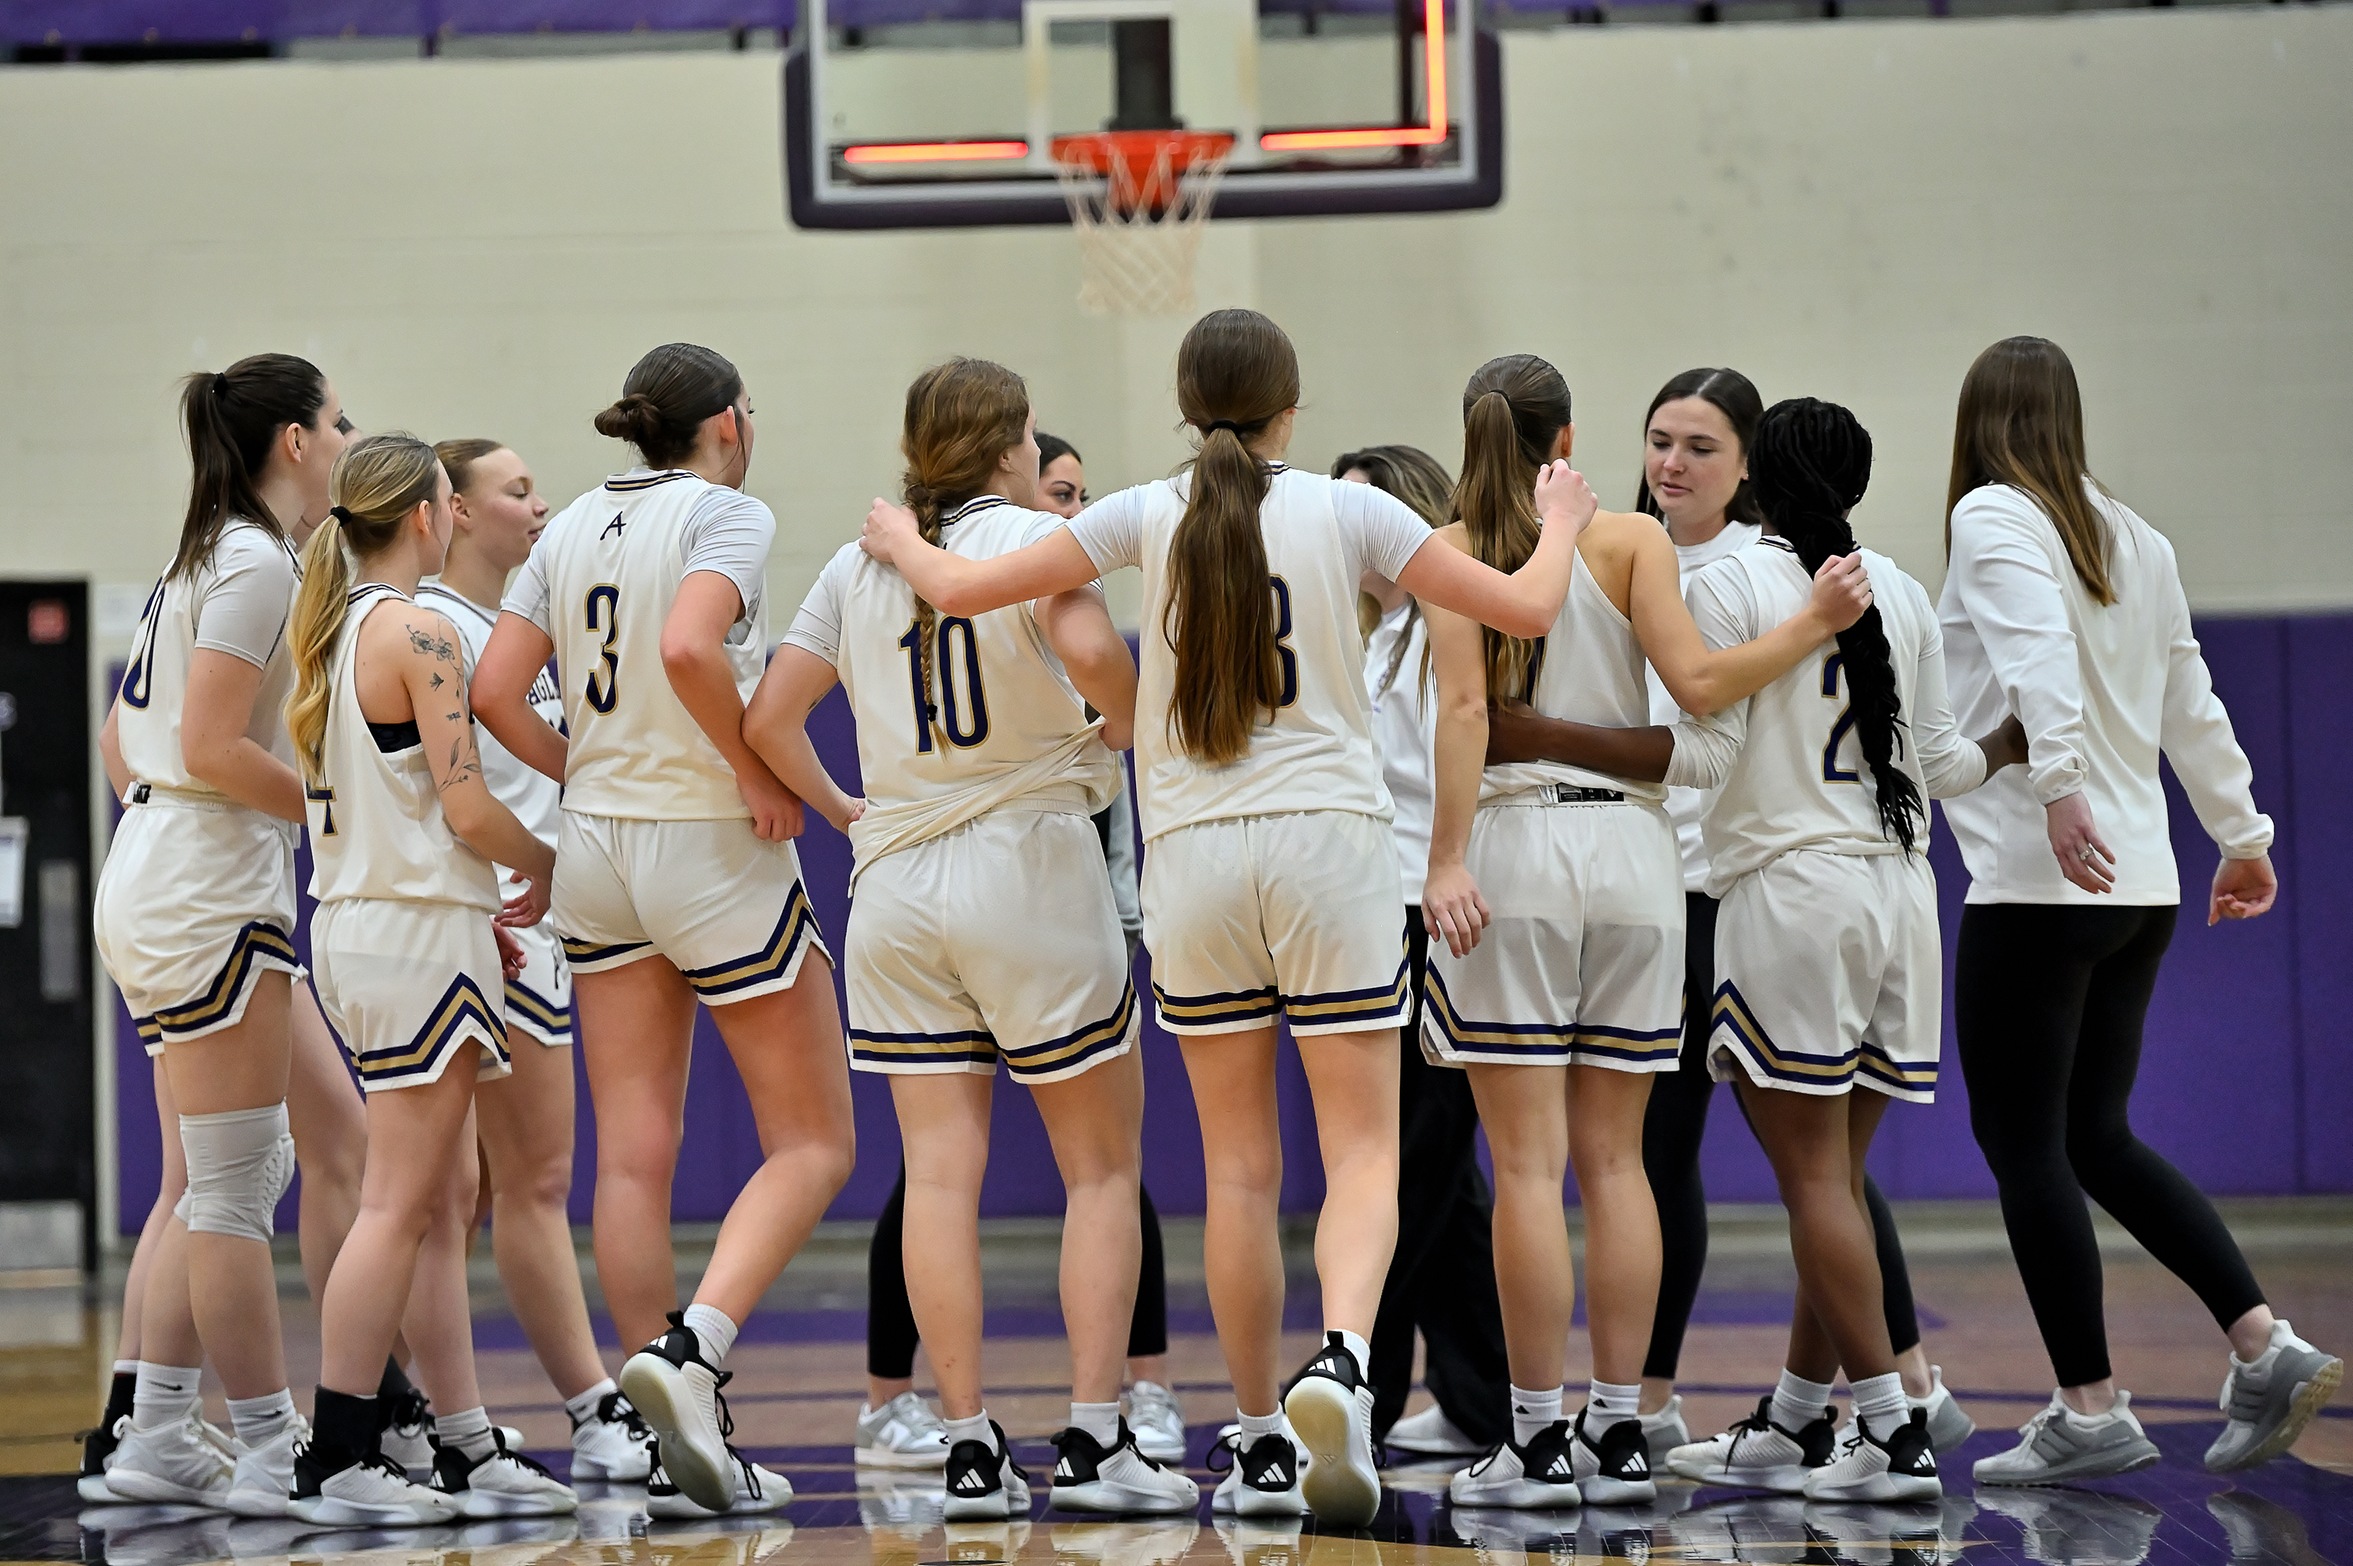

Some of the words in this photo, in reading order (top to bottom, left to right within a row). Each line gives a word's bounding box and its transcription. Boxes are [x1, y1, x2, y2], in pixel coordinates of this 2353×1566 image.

[600, 511, 626, 541] A
[584, 582, 621, 716] 3
[898, 614, 991, 755] 10
[1820, 649, 1862, 784] 2
